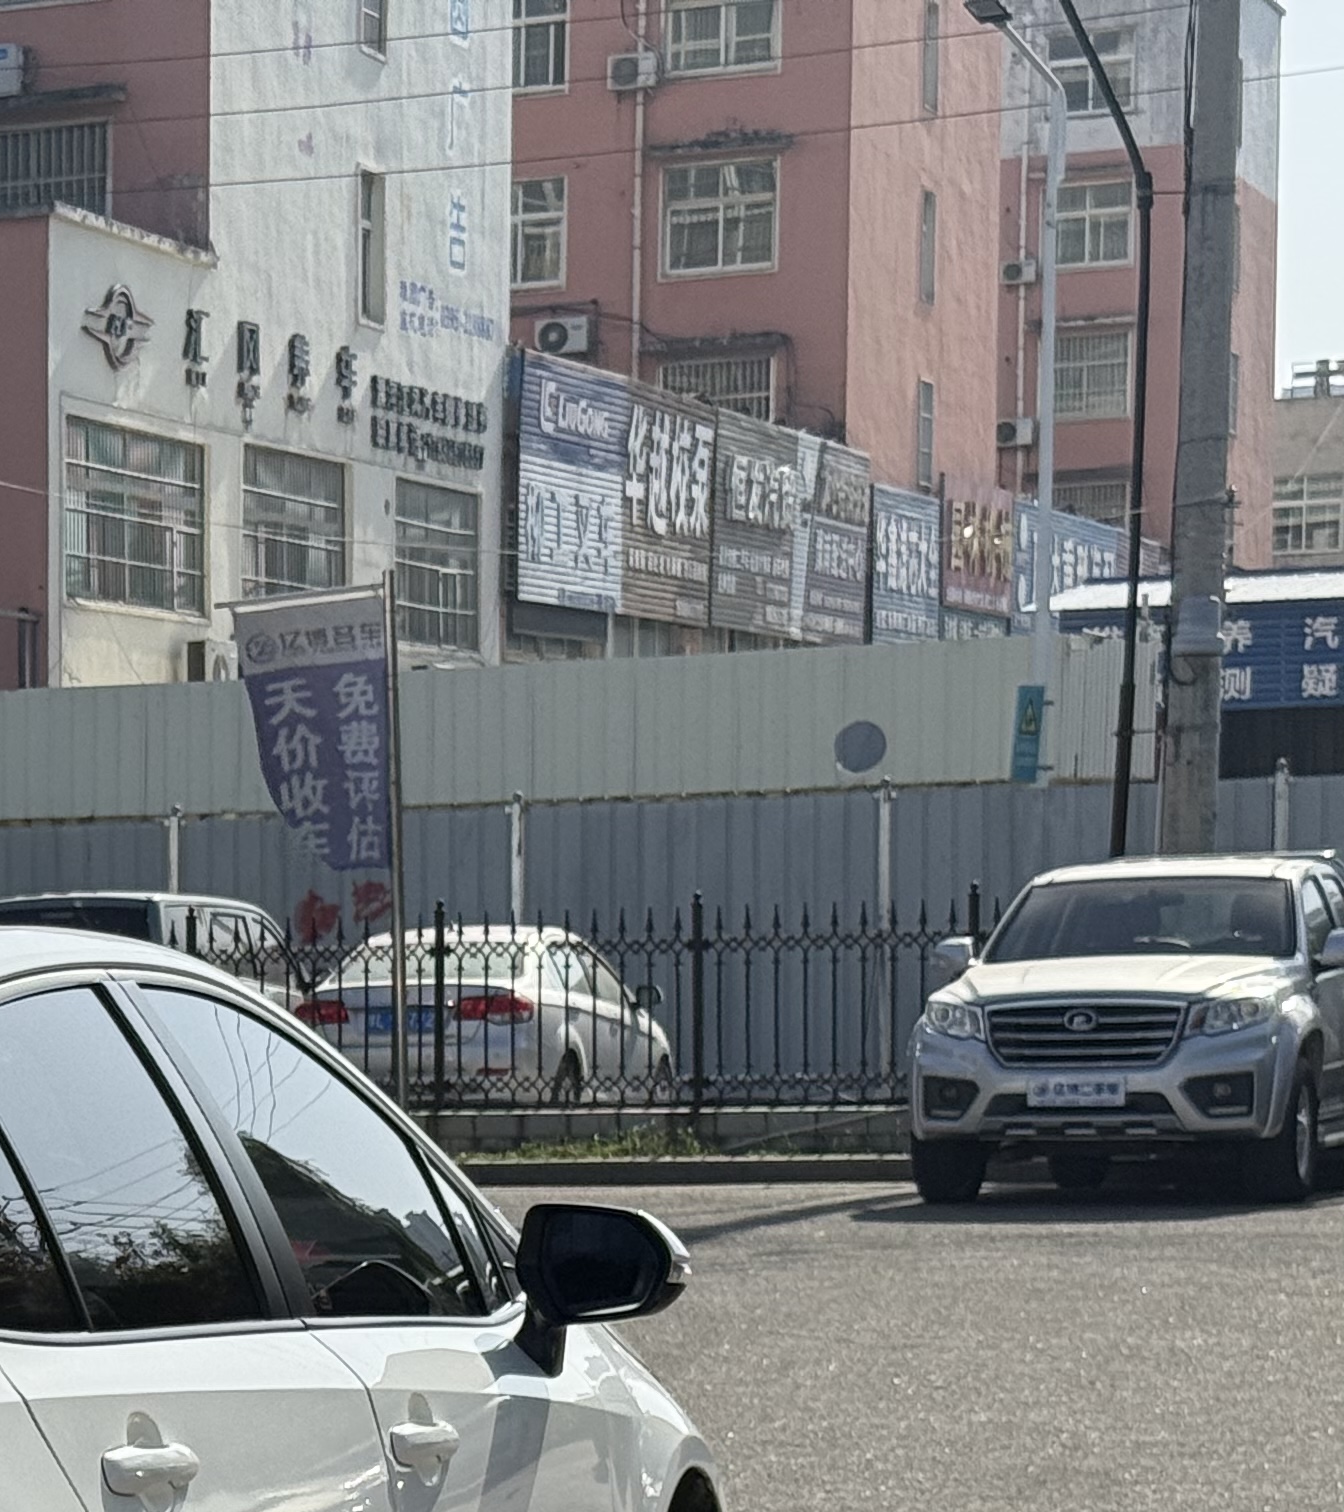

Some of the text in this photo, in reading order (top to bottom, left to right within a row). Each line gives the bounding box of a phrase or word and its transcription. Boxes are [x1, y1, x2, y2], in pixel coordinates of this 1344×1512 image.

[265, 677, 331, 866] 天价收车
[333, 672, 383, 862] 免费评估
